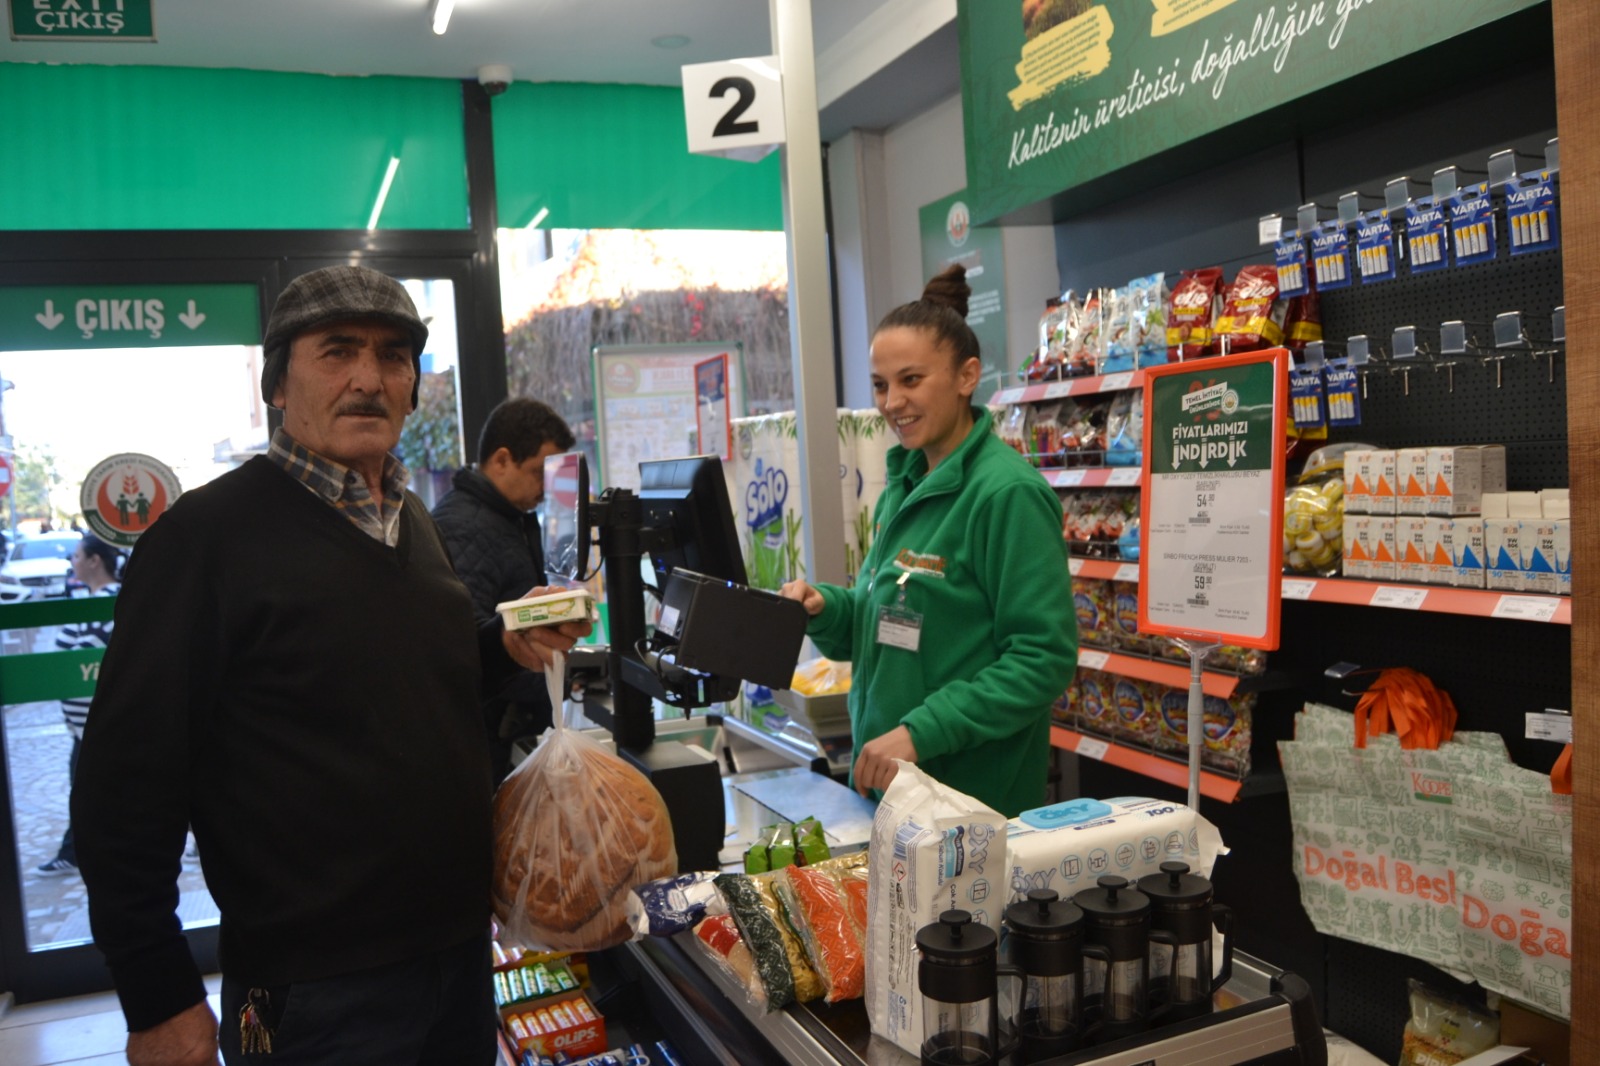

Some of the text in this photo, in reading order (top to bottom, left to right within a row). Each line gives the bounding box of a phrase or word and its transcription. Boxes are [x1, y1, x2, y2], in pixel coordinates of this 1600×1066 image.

[35, 11, 125, 33] ÇIKIŞ
[1007, 112, 1091, 169] Kalitenin
[1094, 58, 1185, 128] üreticisi,
[1191, 2, 1329, 100] doğallığın
[708, 75, 759, 138] 2
[1507, 187, 1552, 204] VARTA
[1452, 199, 1490, 216] VARTA
[1408, 210, 1442, 226] VARTA
[1358, 223, 1390, 238] VARTA
[1313, 234, 1347, 247] VARTA
[1276, 243, 1304, 256] VARTA
[75, 299, 165, 339] ÇIKIŞ
[1291, 376, 1320, 387] VARTA
[1327, 371, 1356, 382] VARTA
[1185, 395, 1202, 405] TEMEL
[1172, 421, 1248, 439] FİYATLARIMIZI
[1171, 437, 1247, 468] İNDİRDİK
[1197, 494, 1207, 507] 54
[1198, 554, 1216, 562] PRESS
[1194, 575, 1205, 589] 59
[1145, 806, 1174, 817] 100
[968, 823, 989, 875] OXY
[1304, 845, 1389, 892] Doğal
[1463, 894, 1572, 960] Doğa
